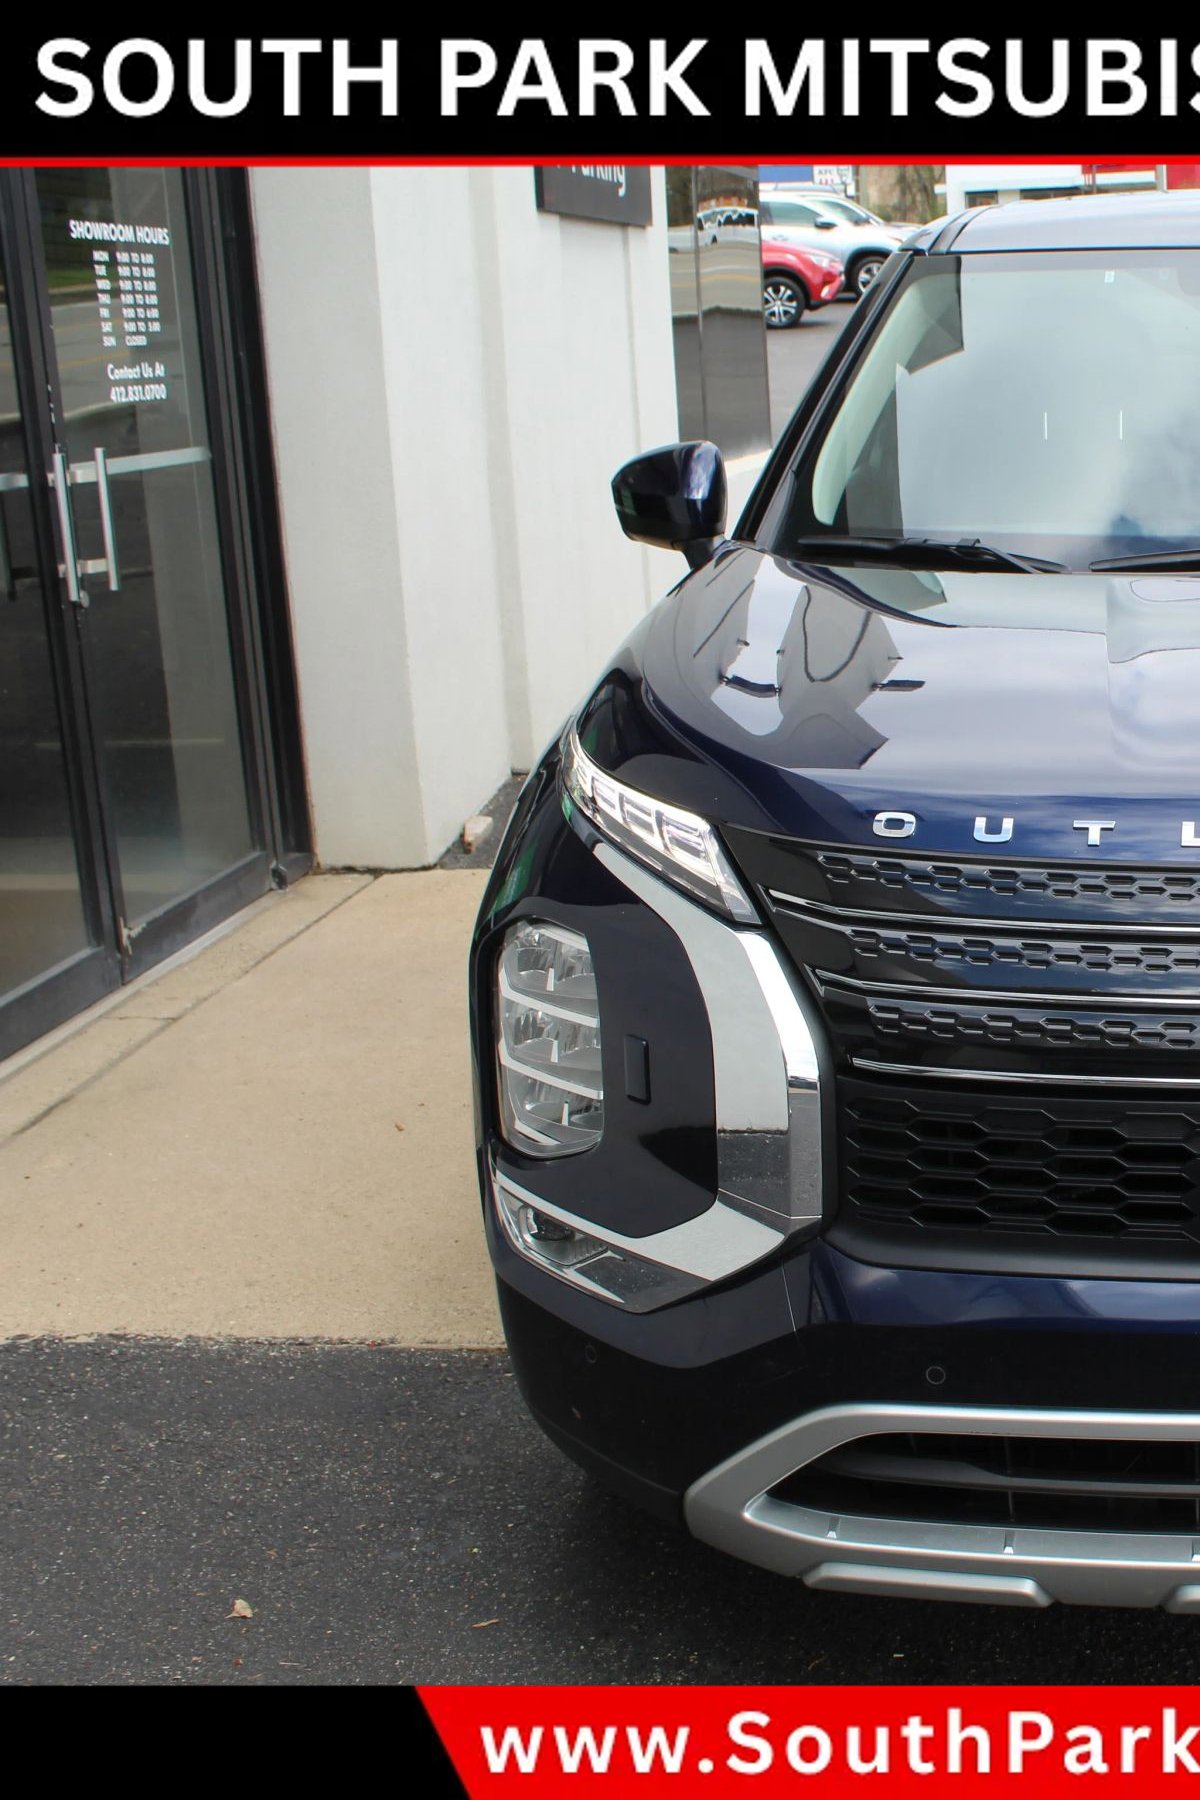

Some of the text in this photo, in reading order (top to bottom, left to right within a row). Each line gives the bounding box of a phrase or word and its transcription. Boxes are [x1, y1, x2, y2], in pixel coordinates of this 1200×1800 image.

[69, 219, 170, 245] SHOWROOM HOURS
[107, 361, 165, 380] Contact Us At
[110, 383, 167, 403] 412.831.0700
